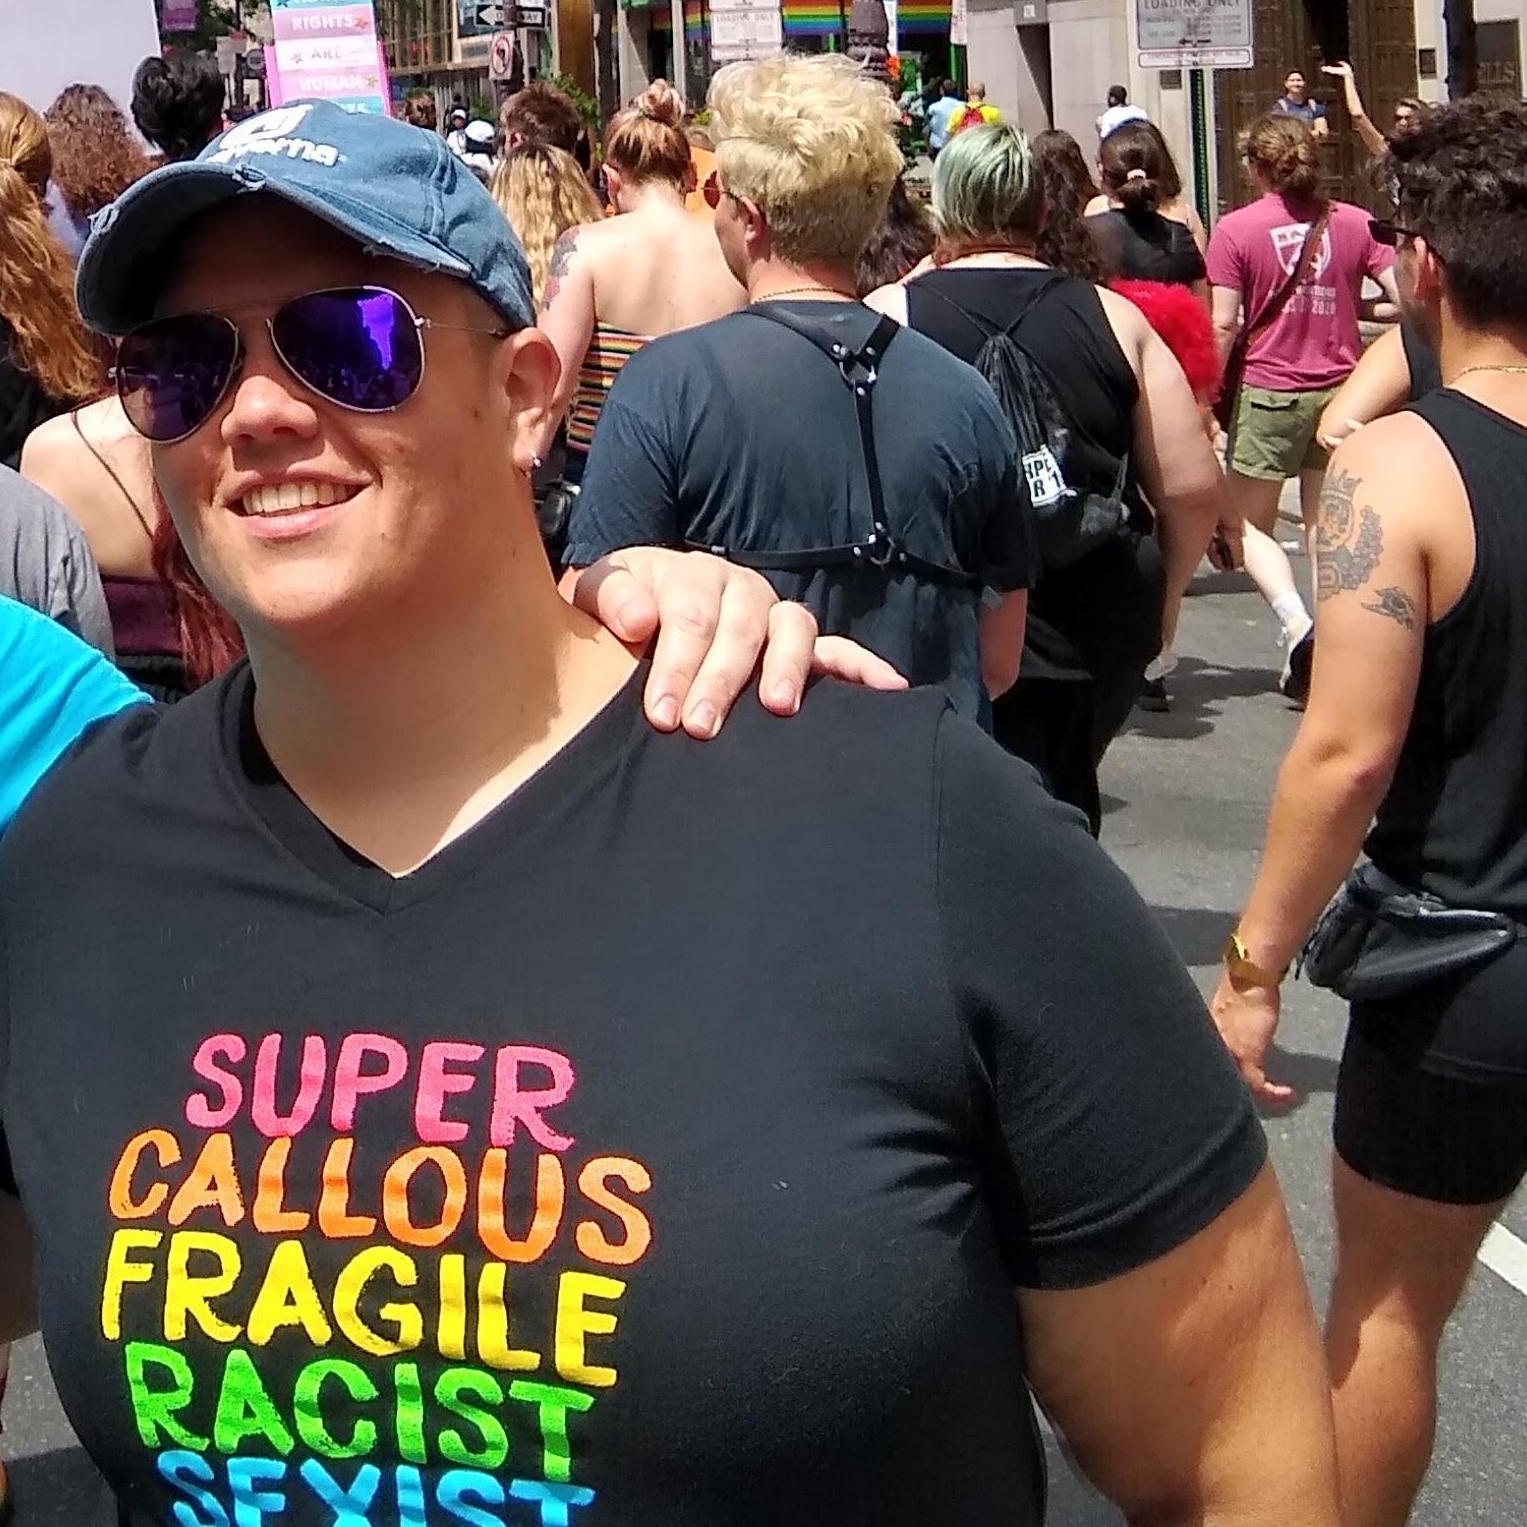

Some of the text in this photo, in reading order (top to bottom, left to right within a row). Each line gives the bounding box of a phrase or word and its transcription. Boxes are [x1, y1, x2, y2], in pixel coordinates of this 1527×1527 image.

[292, 13, 352, 31] RIGHTS
[311, 47, 343, 60] ARE
[298, 75, 364, 92] HUMAN
[184, 1032, 576, 1152] SUPER
[109, 1128, 653, 1266] CALLOUS
[101, 1228, 627, 1388] FRAGILE
[124, 1340, 596, 1483] RACIST
[158, 1449, 596, 1527] SEXIST
